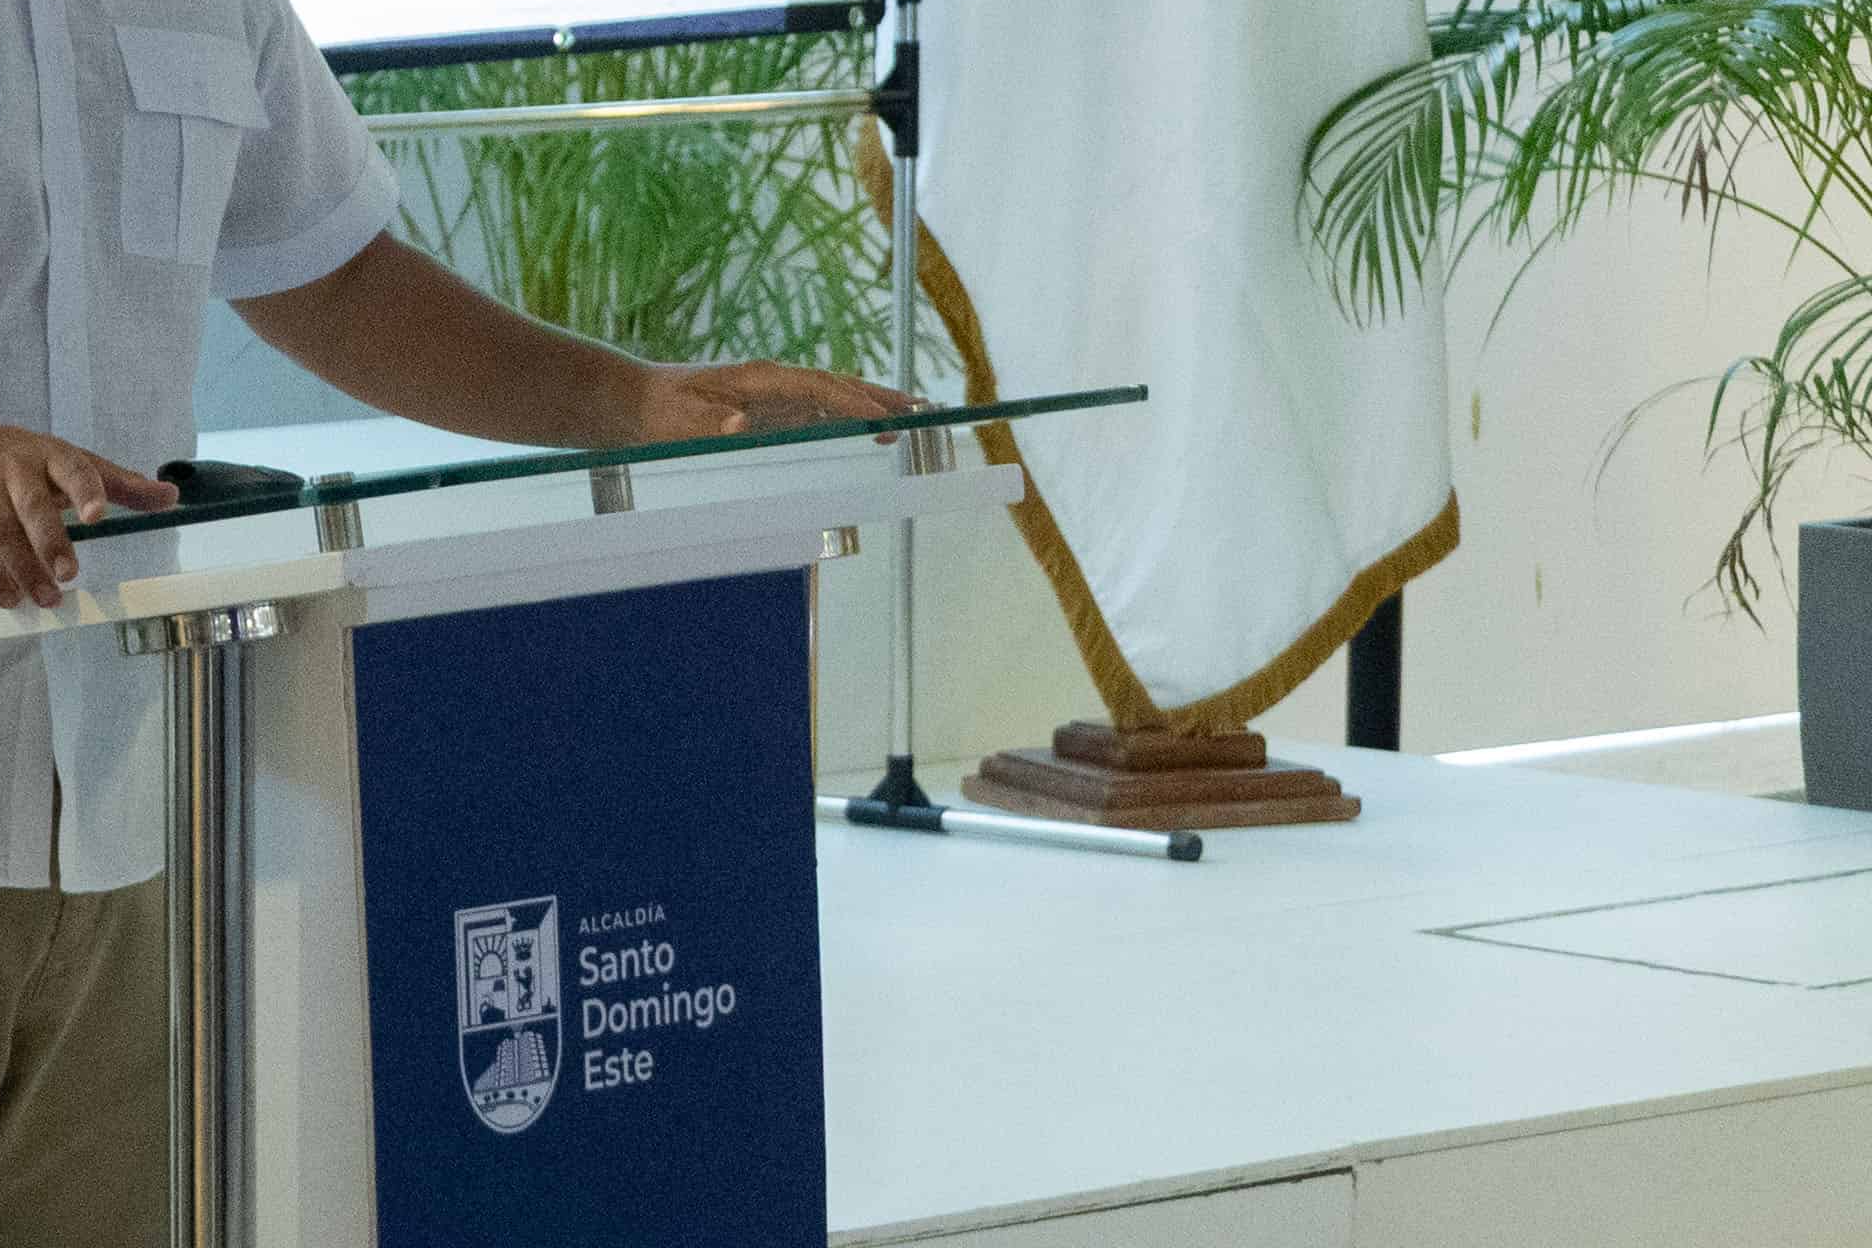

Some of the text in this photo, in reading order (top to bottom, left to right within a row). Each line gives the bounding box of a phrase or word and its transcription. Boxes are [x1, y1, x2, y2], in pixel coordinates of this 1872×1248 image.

[578, 903, 666, 936] ALCALDÍA
[580, 939, 675, 986] Santo
[582, 982, 736, 1039] Domingo
[584, 1047, 654, 1091] Este
